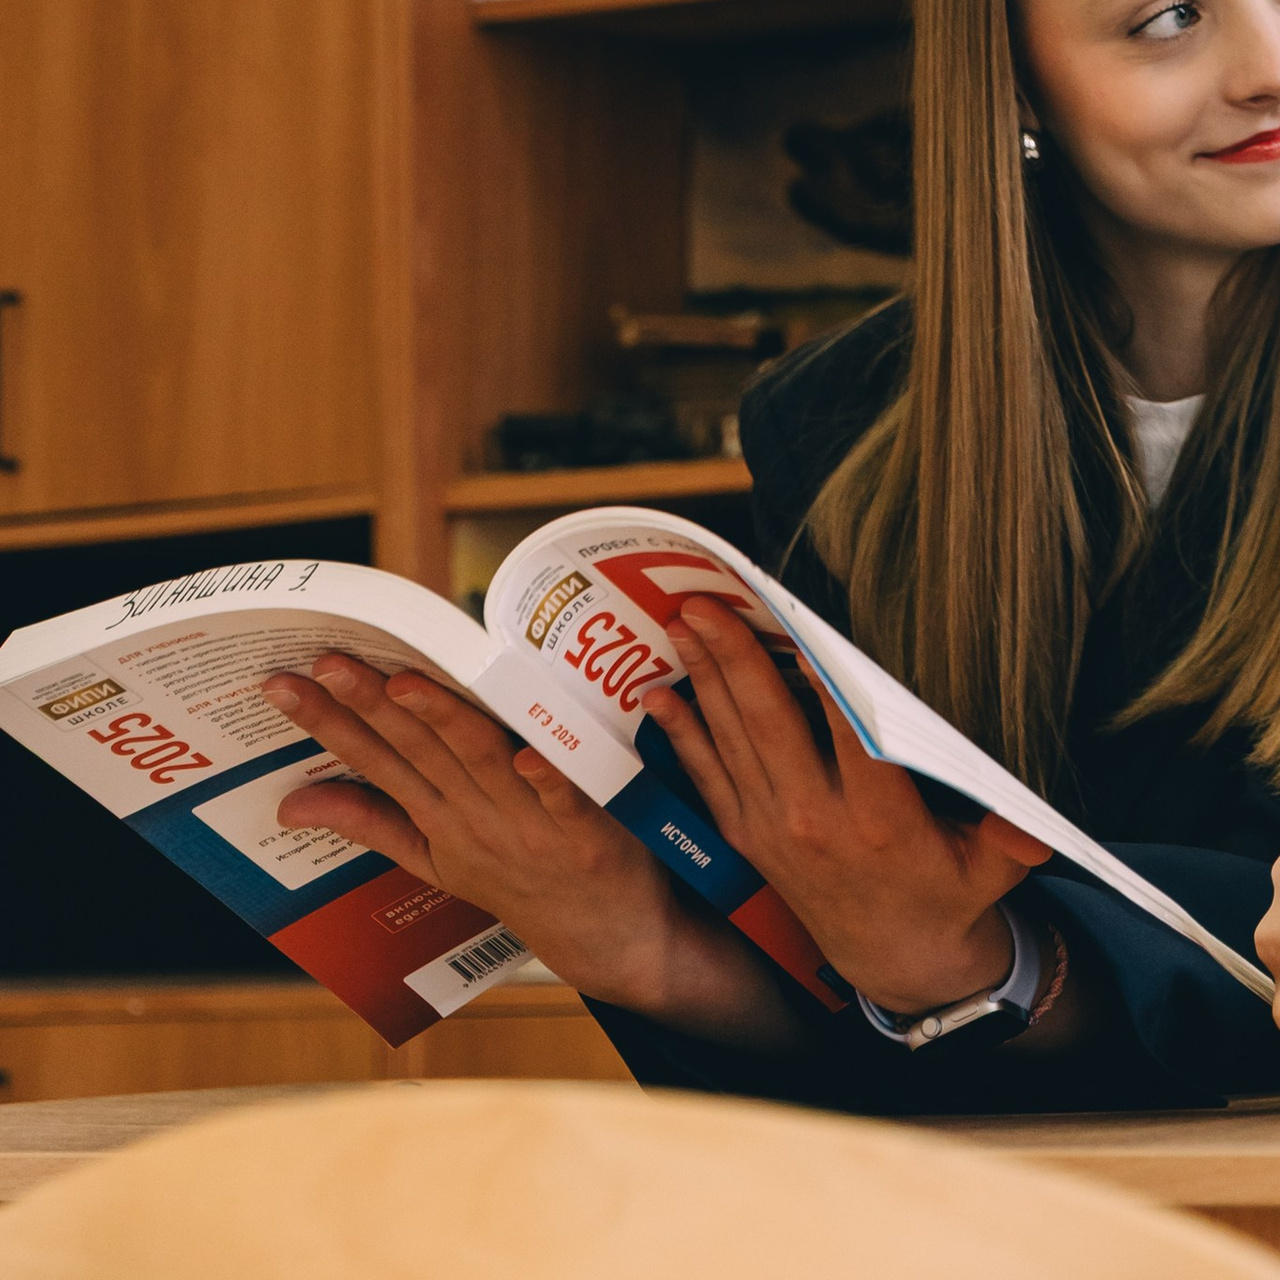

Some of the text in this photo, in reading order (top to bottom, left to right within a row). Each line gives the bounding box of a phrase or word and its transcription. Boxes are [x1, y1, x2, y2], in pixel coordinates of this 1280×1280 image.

[577, 538, 640, 559] ПРОЕКТ
[531, 576, 584, 640] ФИПИ
[547, 592, 595, 651] ШКОЛЕ
[118, 650, 143, 665] ДЛЯ
[564, 611, 675, 713] 2025
[50, 682, 117, 716] ФИПИ
[67, 697, 129, 726] ШКОЛЕ
[186, 700, 212, 715] ДЛЯ
[220, 707, 275, 730] деятельнос
[527, 702, 581, 752] ЕГЭ 2025
[87, 712, 214, 784] 2025
[305, 759, 341, 776] КОМП
[276, 842, 312, 862] История
[311, 830, 336, 843] Росс
[311, 845, 347, 865] История
[660, 821, 712, 869] ИСТОРИЯ
